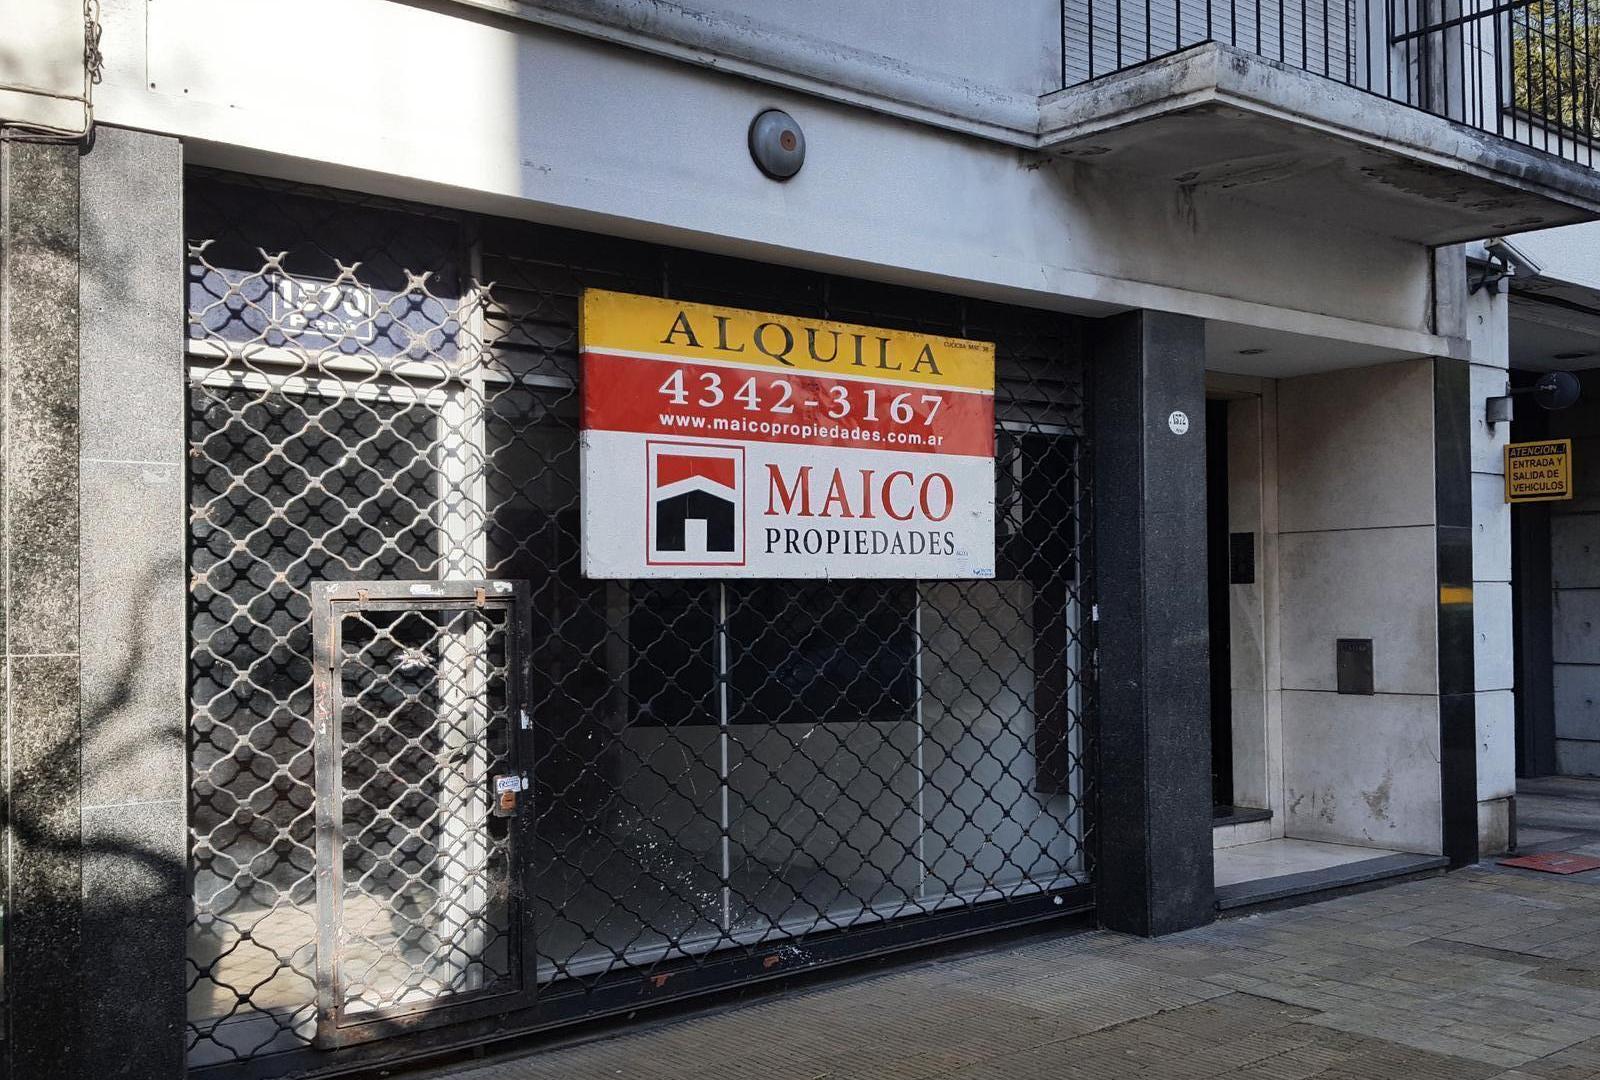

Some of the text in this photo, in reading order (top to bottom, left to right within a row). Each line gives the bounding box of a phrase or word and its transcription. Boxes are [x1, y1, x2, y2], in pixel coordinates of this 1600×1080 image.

[660, 310, 943, 376] ALQUILA
[658, 369, 943, 426] 4342-3167
[659, 412, 944, 446] www.maicopropiedades.com.ar
[1513, 457, 1563, 469] ENTRADA Y
[1513, 469, 1560, 480] SALIDA DE
[763, 463, 954, 522] MAICO
[1513, 481, 1564, 492] VEHICULOS
[764, 527, 955, 556] PROPIEDADES
